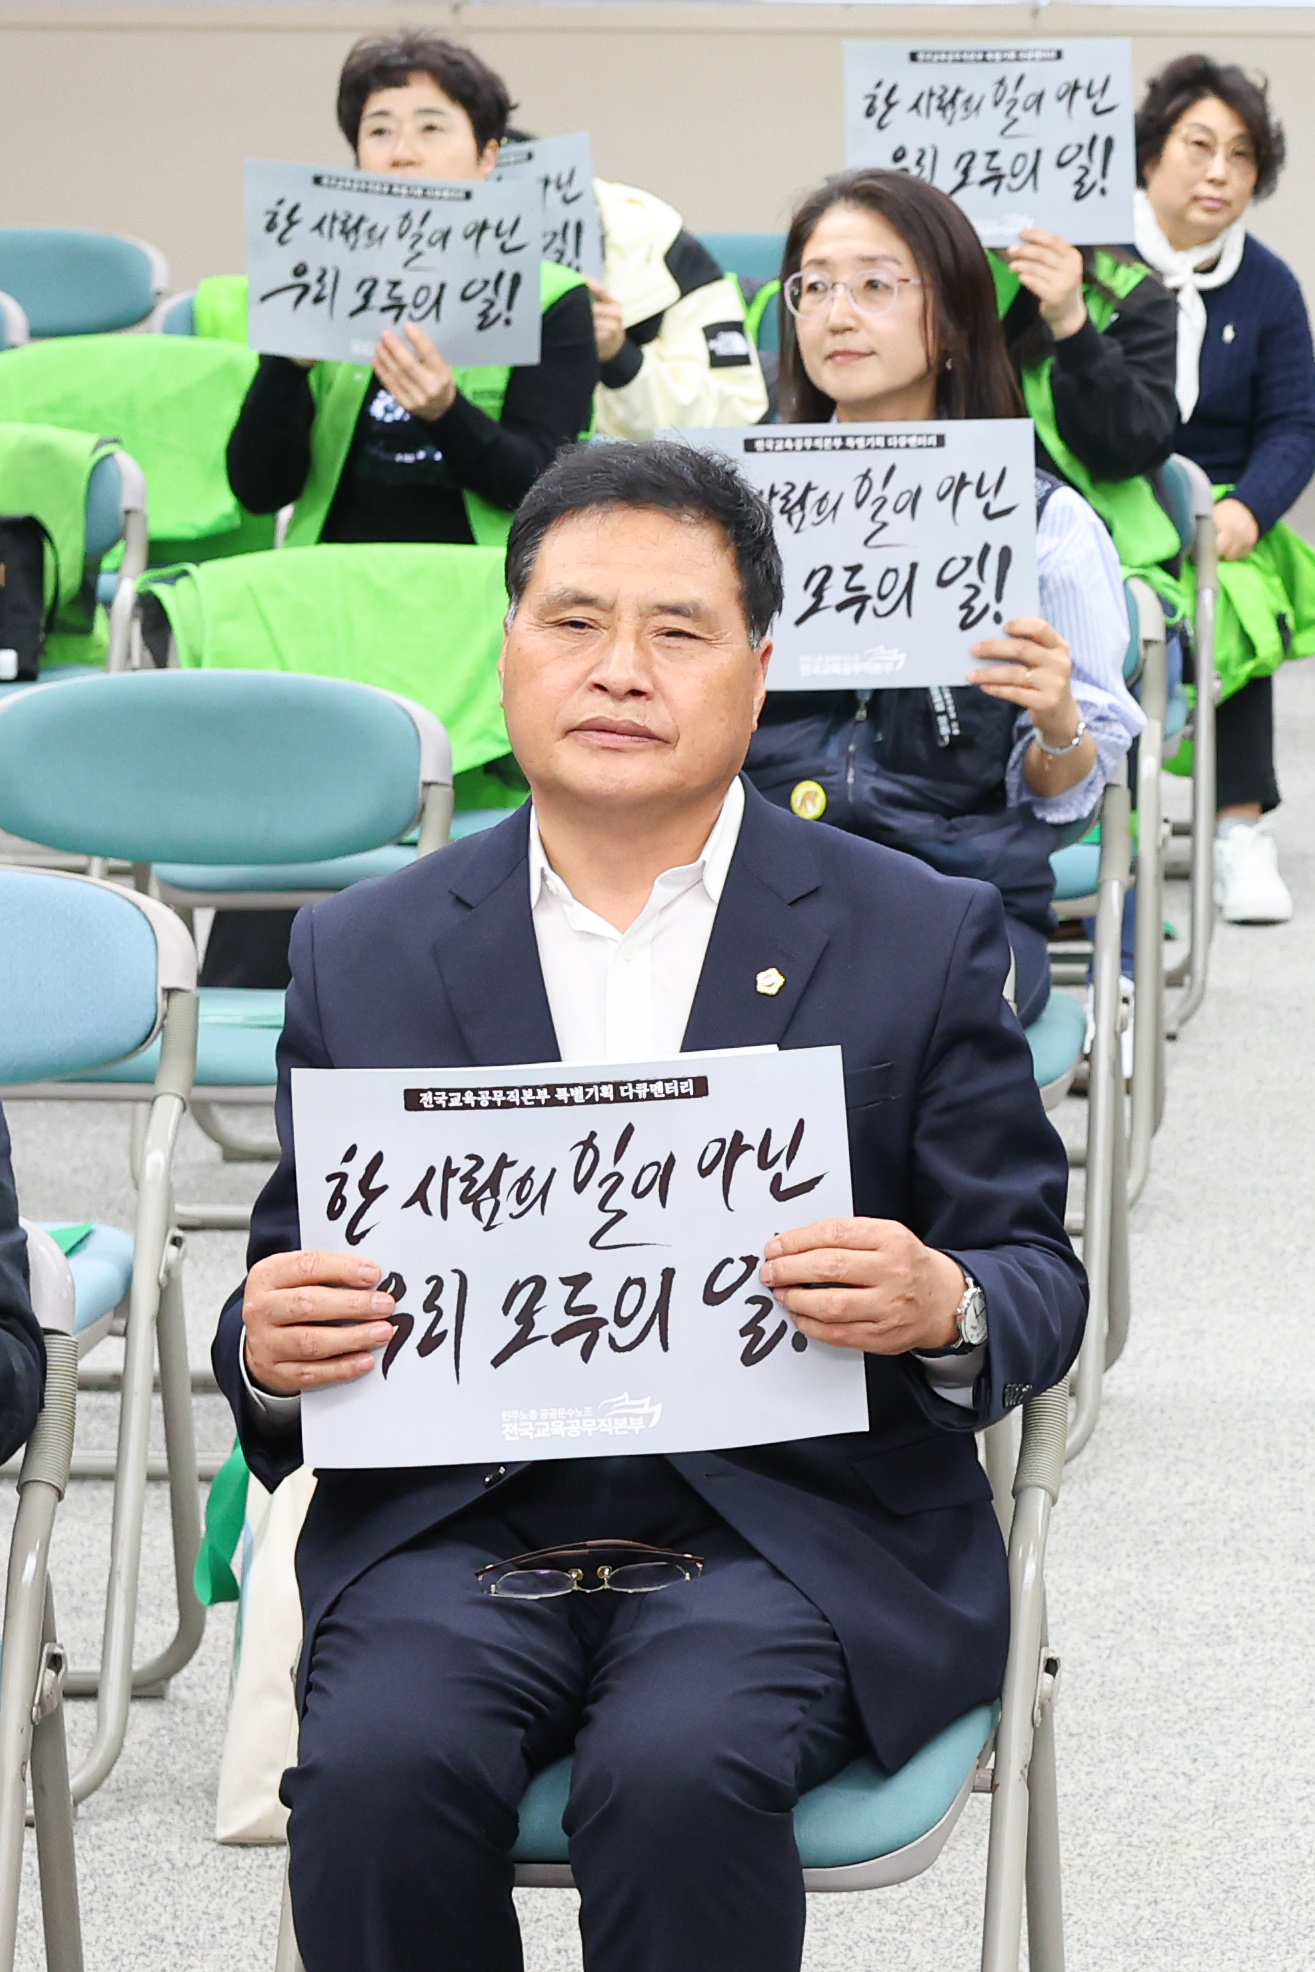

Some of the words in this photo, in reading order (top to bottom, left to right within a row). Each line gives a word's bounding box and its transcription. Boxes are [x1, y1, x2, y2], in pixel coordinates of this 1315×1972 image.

[864, 79, 899, 131] 한
[907, 84, 985, 126] 사람의
[1056, 74, 1120, 118] 아닌
[949, 148, 1042, 197] 모두의
[1056, 133, 1115, 202] 일!
[264, 197, 302, 247] 한
[309, 210, 390, 252] 사람의
[462, 215, 529, 258] 아닌
[259, 261, 340, 321] 우리
[348, 276, 447, 324] 모두의
[459, 269, 523, 333] 일!
[854, 462, 922, 549] 일이
[936, 466, 1020, 526] 아닌
[794, 561, 919, 628] 모두의
[935, 542, 1013, 632] 일!
[418, 1087, 551, 1109] 전국교육공무직본부
[554, 1083, 615, 1105] 특별기획
[619, 1078, 695, 1100] 다큐멘터리
[325, 1143, 390, 1247] 한
[400, 1151, 557, 1232] 사람의
[569, 1121, 677, 1251] 일이
[696, 1117, 831, 1213] 아닌
[490, 1266, 677, 1370] 모두의
[702, 1232, 808, 1368] 일
[501, 1408, 538, 1422] 민주노총
[501, 1416, 646, 1441] 전국교육공무직본부
